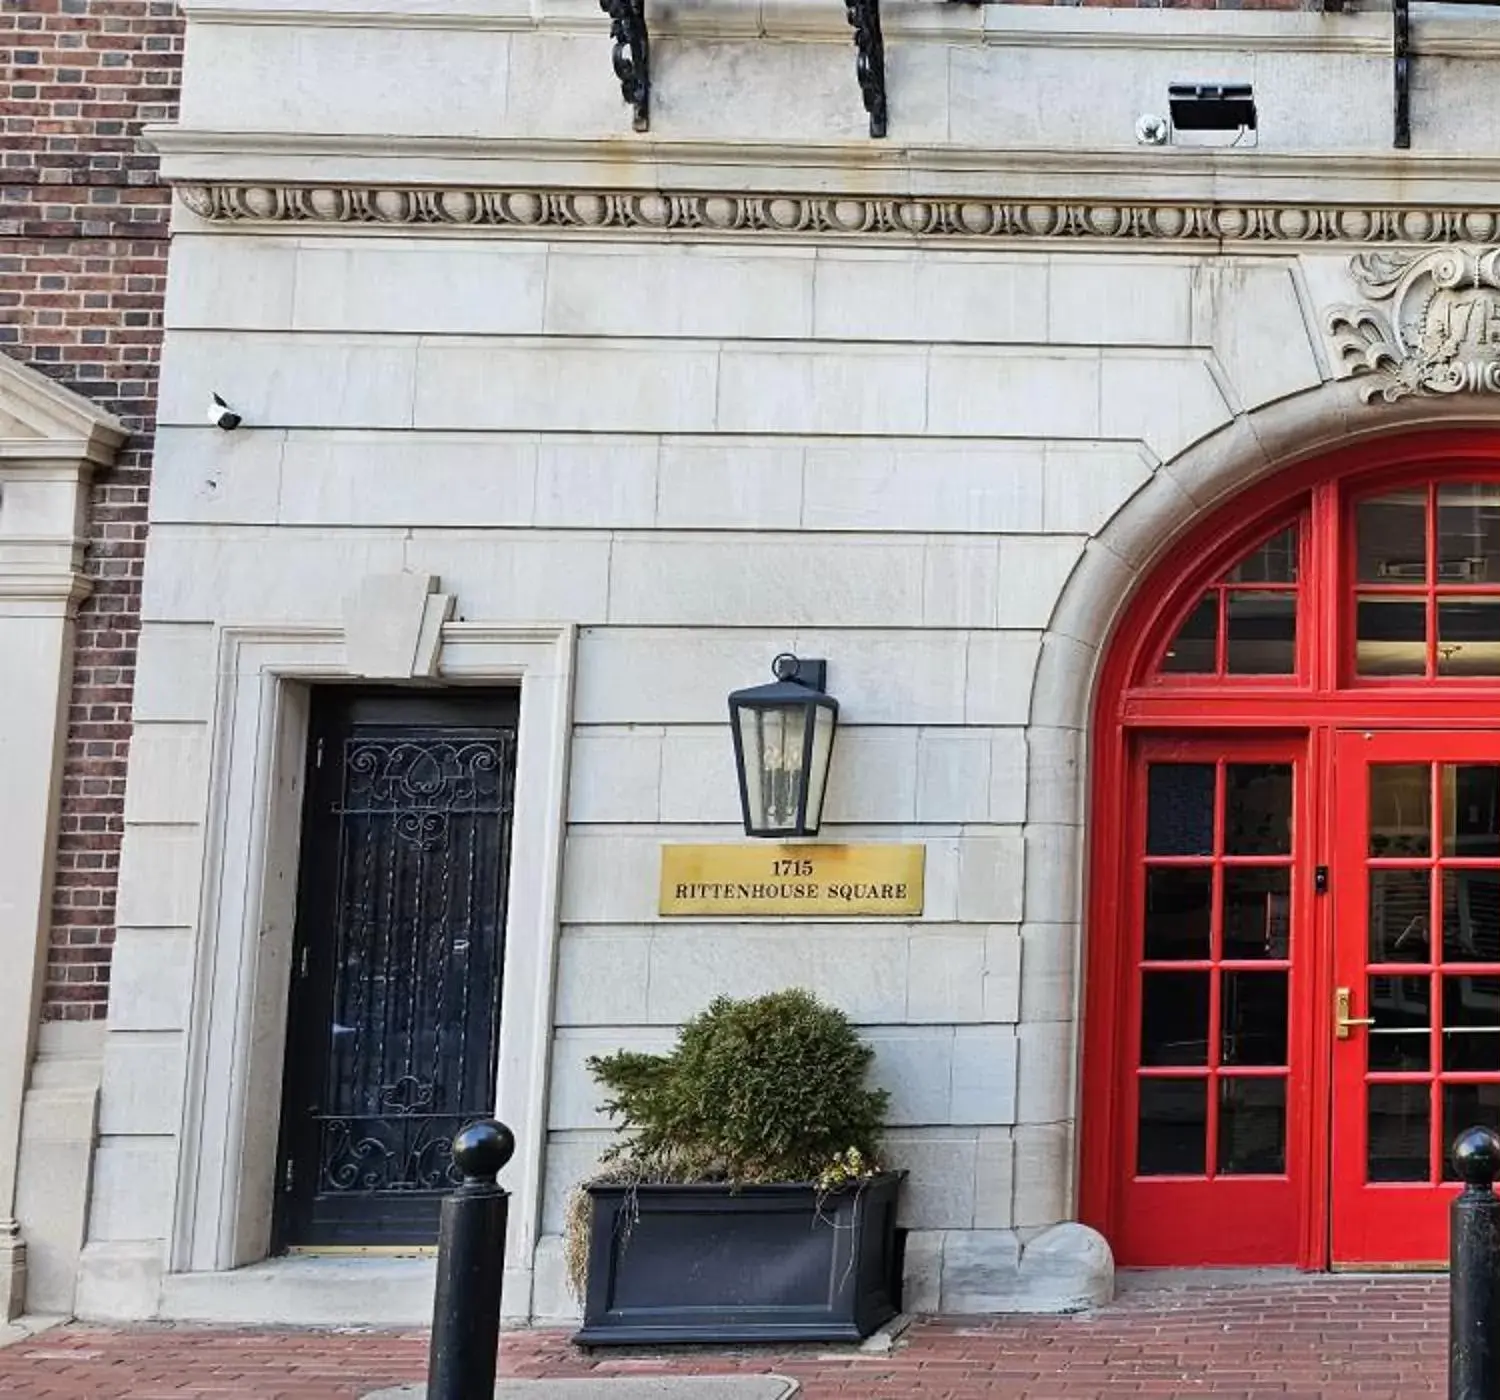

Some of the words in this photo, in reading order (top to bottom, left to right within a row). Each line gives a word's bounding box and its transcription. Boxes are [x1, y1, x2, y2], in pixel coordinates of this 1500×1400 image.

[772, 860, 813, 877] 1715
[675, 883, 819, 899] RITTENHOUSE
[827, 883, 908, 900] SQUARE
